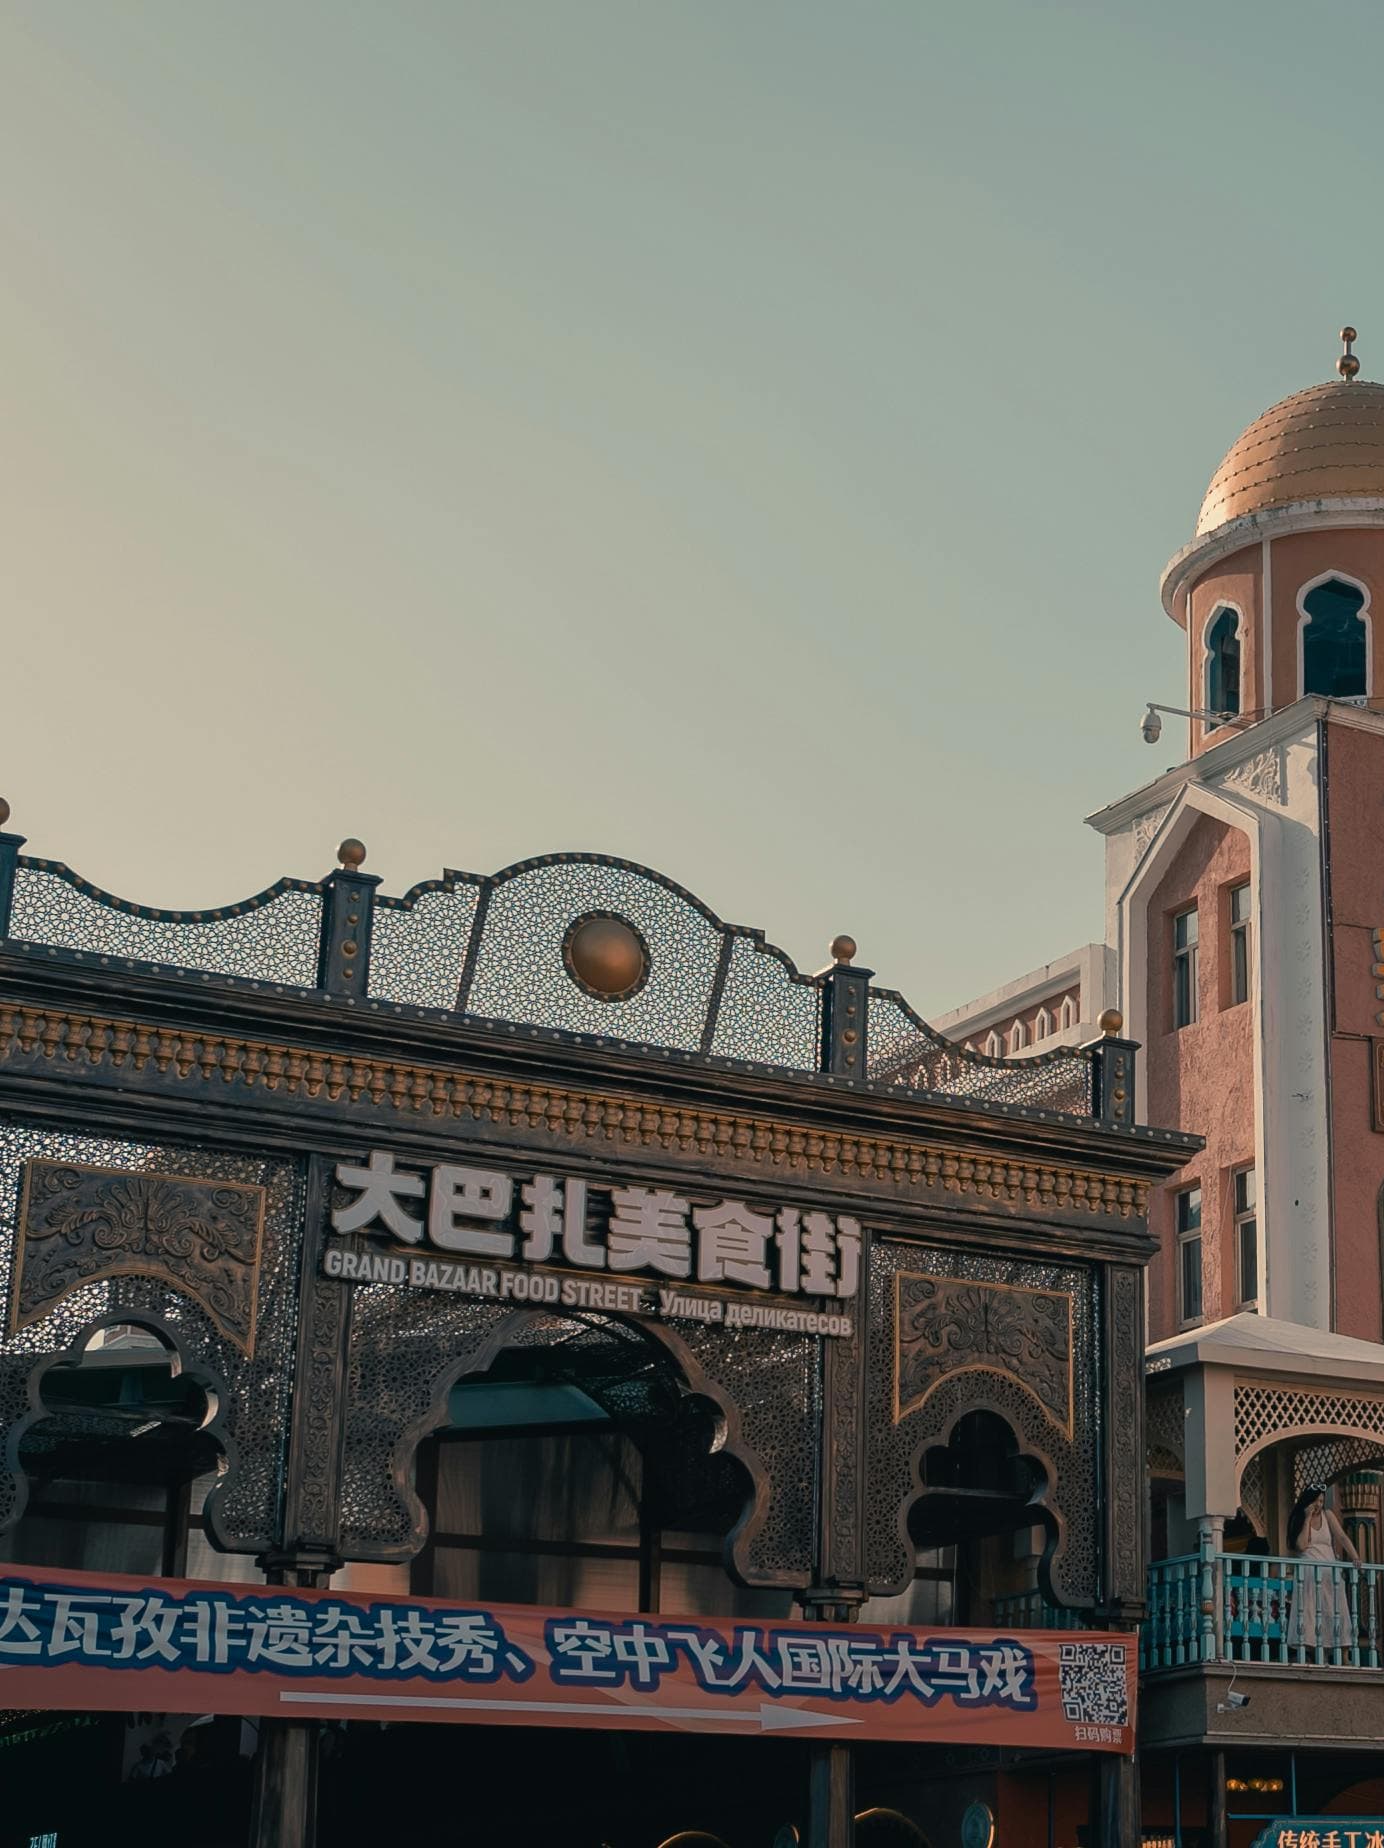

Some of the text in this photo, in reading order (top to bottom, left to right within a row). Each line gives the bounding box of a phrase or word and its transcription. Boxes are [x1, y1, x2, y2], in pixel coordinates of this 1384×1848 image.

[330, 1150, 862, 1298] 大巴扎美食街
[324, 1250, 644, 1311] GRAND BAZAAR FOOD STREET
[659, 1289, 853, 1337] Улица деликатесов
[1075, 1725, 1122, 1744] 扫码购票
